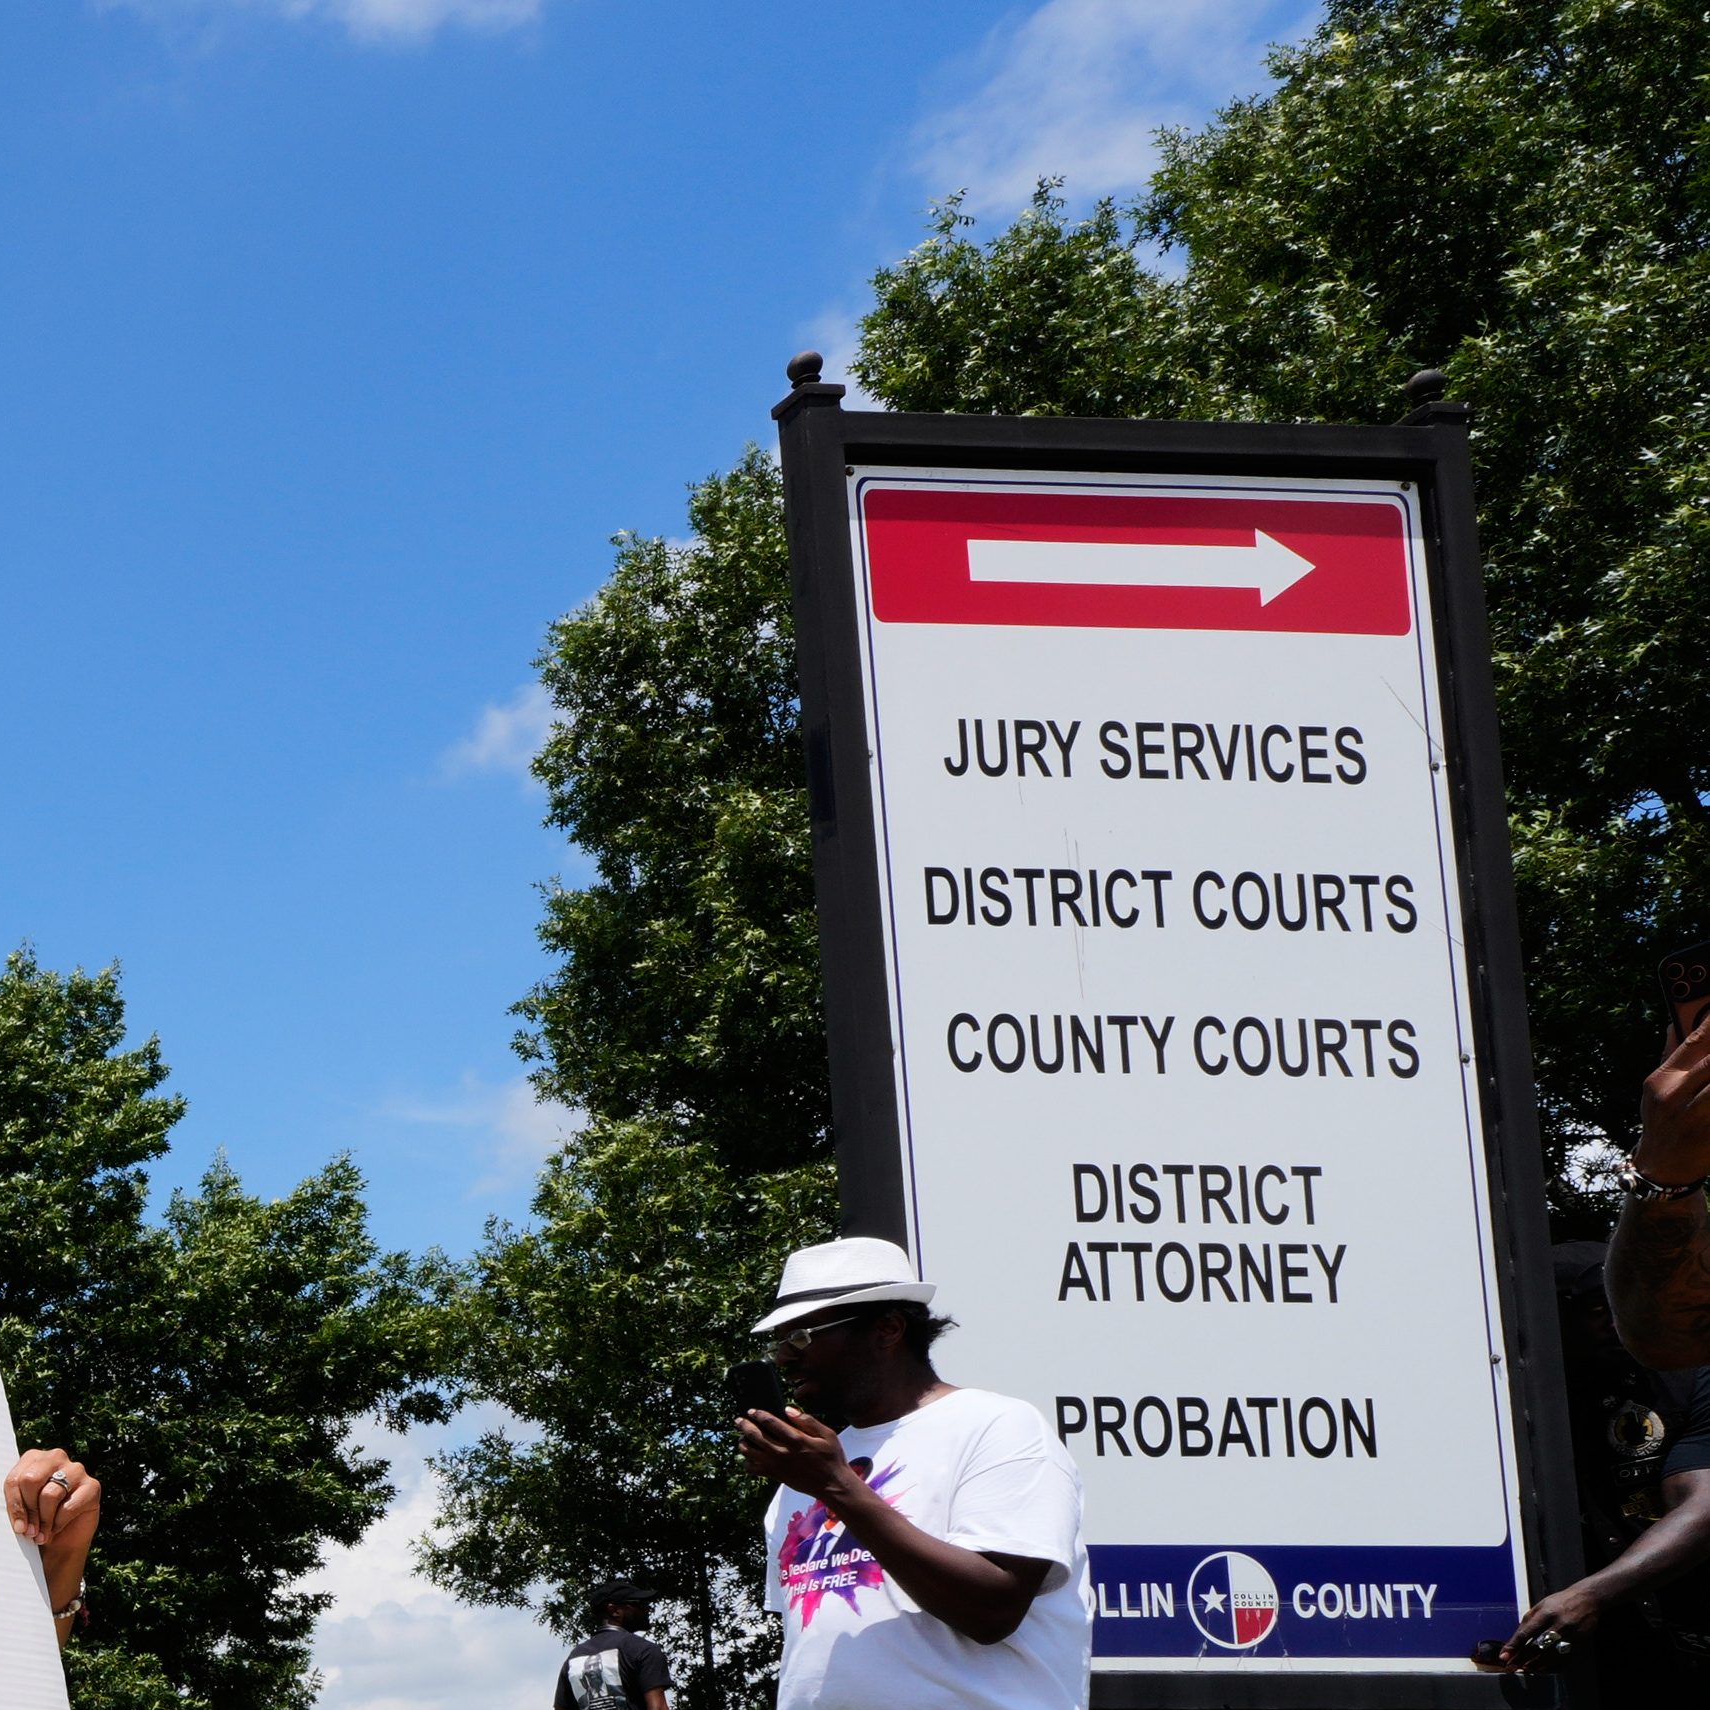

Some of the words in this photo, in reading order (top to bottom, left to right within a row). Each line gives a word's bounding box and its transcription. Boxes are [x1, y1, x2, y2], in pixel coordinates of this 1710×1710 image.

[944, 718, 1081, 778] JURY
[1100, 720, 1367, 785] SERVICES
[925, 867, 1172, 929] DISTRICT
[1192, 870, 1418, 934] COURTS
[947, 1012, 1175, 1075] COUNTY
[1193, 1016, 1420, 1079] COURTS
[1072, 1163, 1322, 1226] DISTRICT
[1057, 1241, 1347, 1304] ATTORNEY
[1055, 1396, 1377, 1459] PROBATION
[808, 1579, 819, 1591] Is
[821, 1571, 858, 1589] FREE
[831, 1553, 849, 1567] We
[1292, 1582, 1438, 1619] COUNTY
